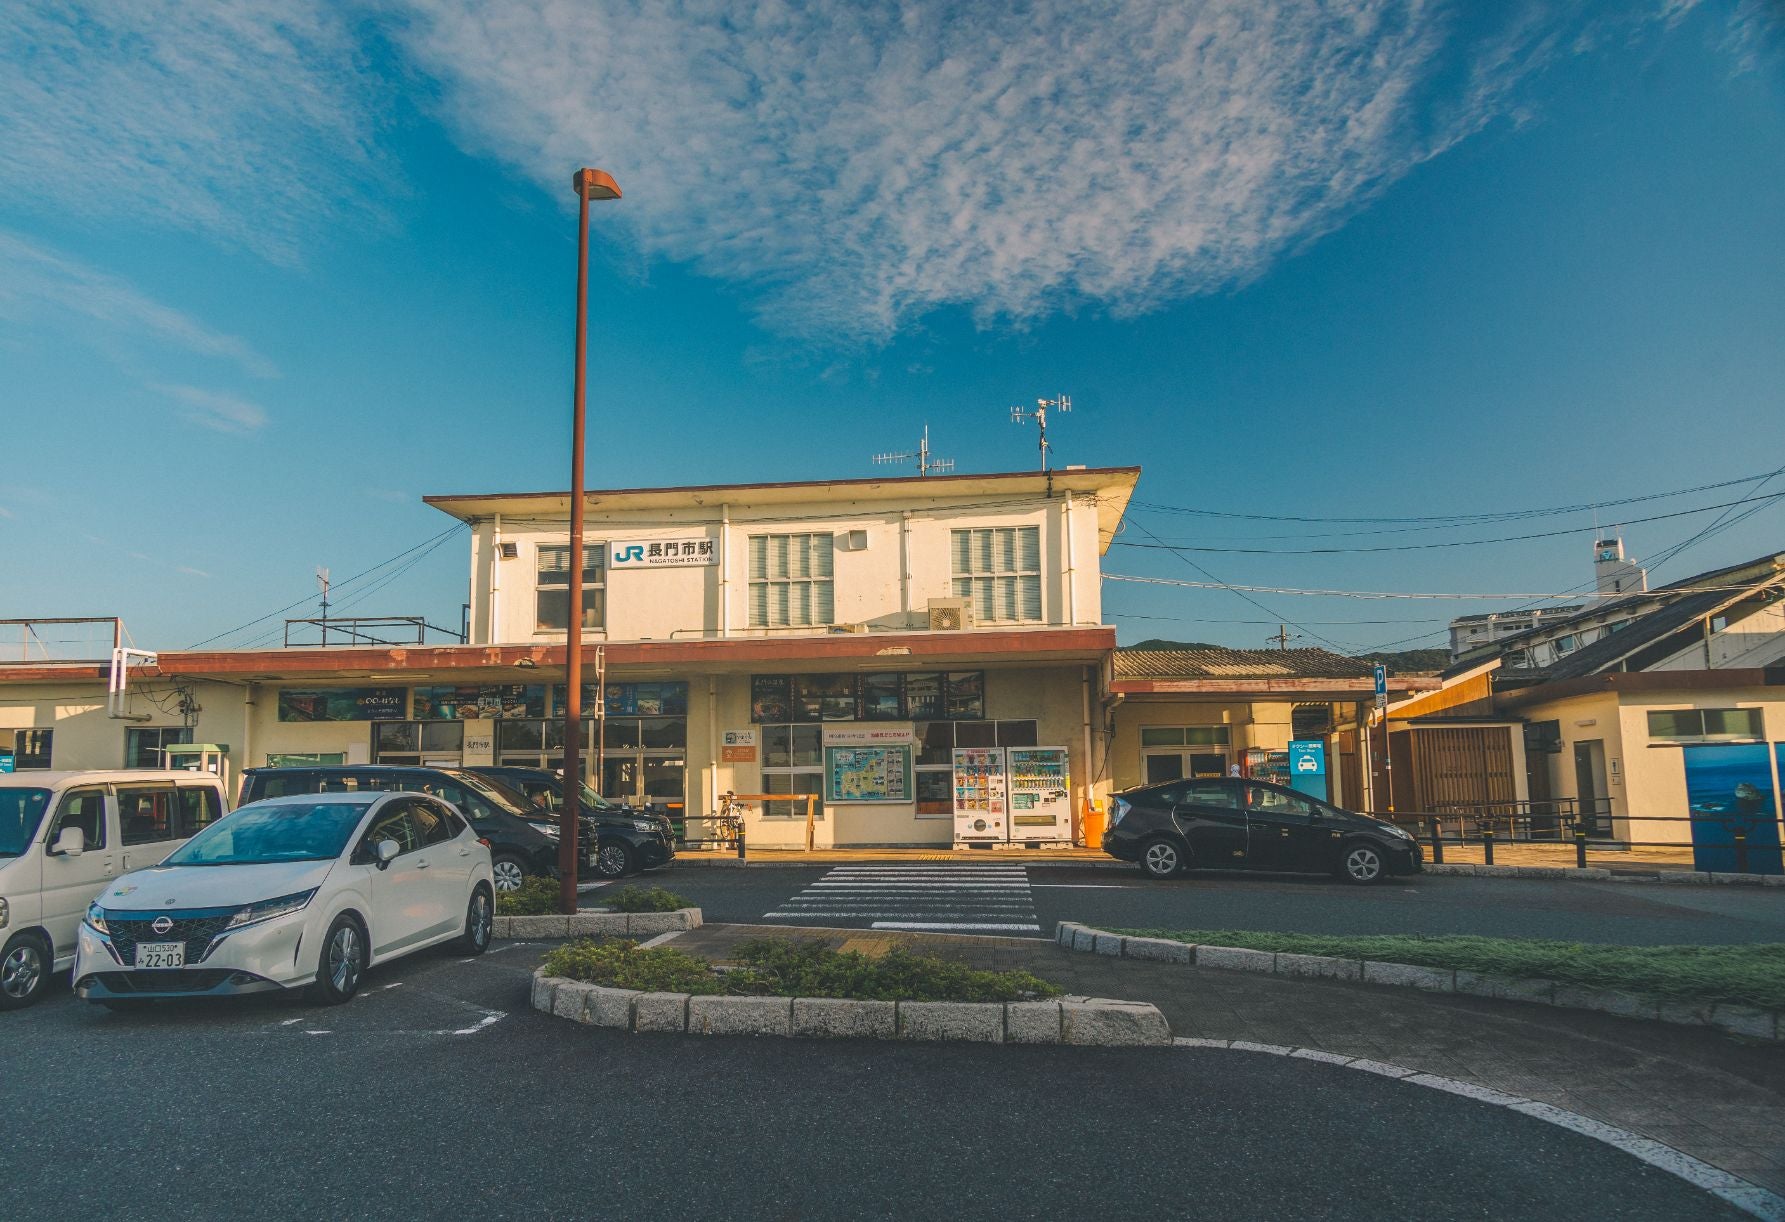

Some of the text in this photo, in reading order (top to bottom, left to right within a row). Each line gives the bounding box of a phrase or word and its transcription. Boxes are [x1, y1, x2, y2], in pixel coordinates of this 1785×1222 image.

[614, 545, 644, 562] JR
[648, 541, 713, 556] 長門市駅
[1376, 669, 1384, 692] P
[147, 944, 175, 953] 山口530
[145, 953, 182, 968] 22-03
